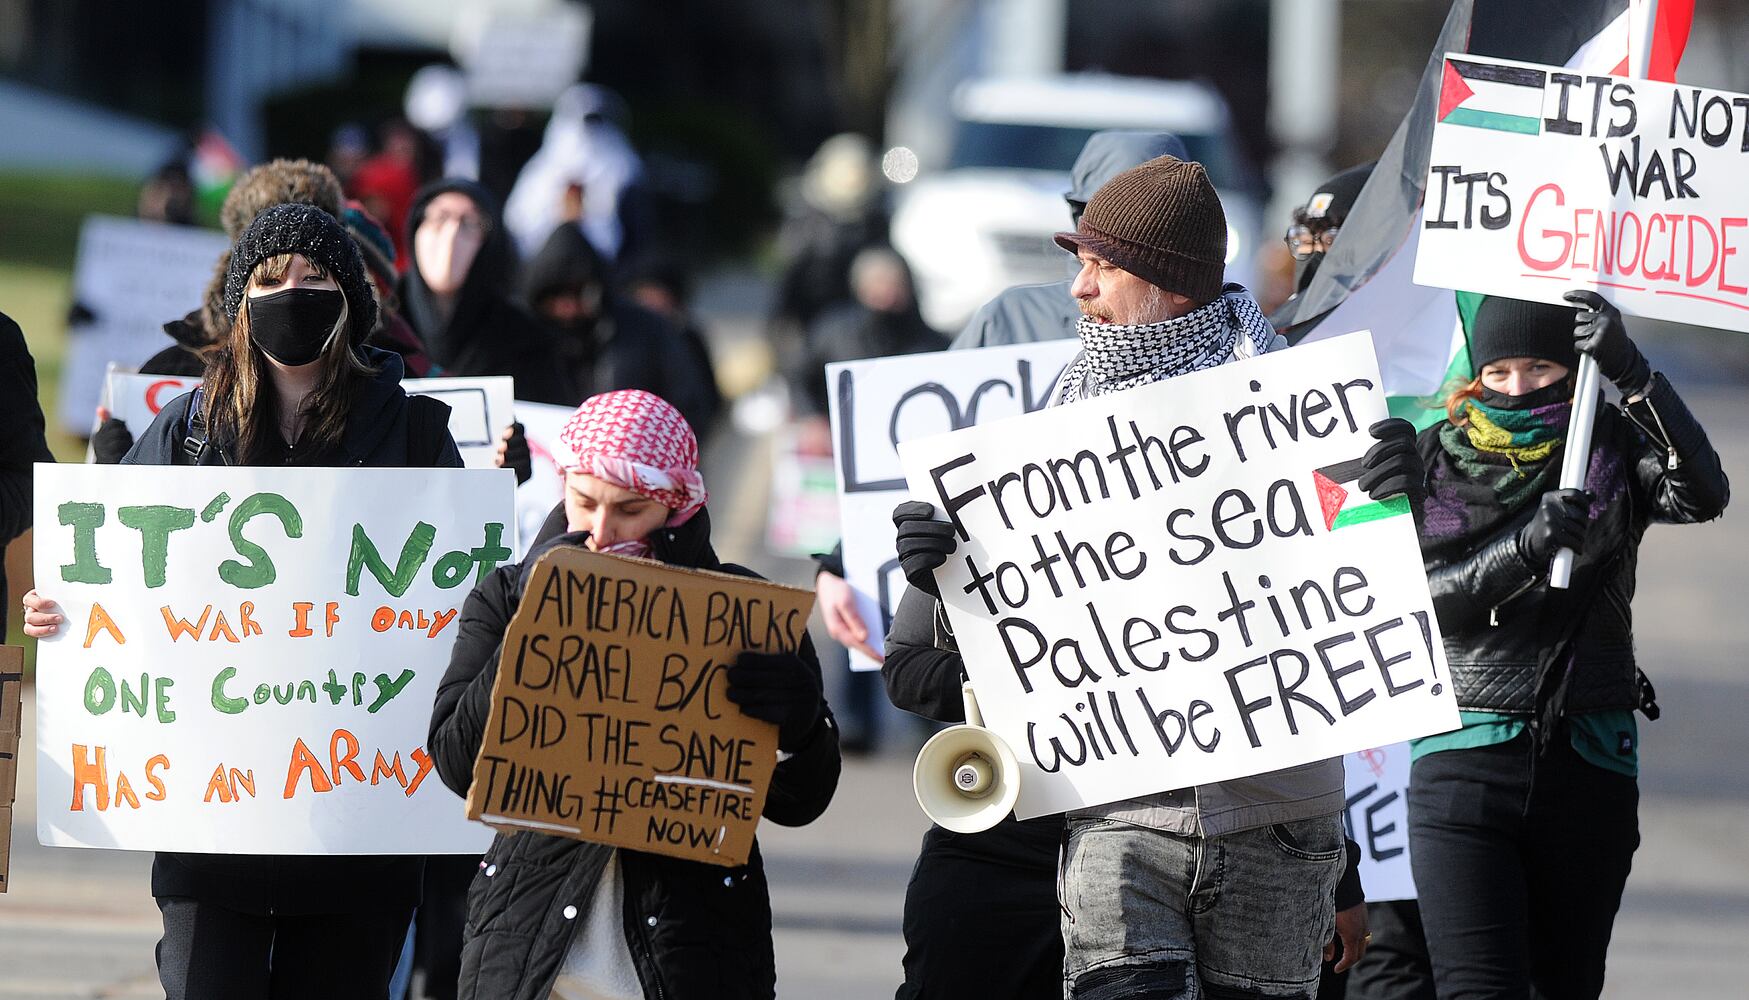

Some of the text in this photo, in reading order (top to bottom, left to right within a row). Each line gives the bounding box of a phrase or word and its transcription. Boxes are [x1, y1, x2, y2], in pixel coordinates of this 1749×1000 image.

[1544, 72, 1638, 138] ITS
[1599, 134, 1701, 201] WAR
[1425, 165, 1748, 296] ITS GENOCIDE
[1222, 378, 1375, 464] river
[57, 492, 512, 597] IT'S Not
[1167, 478, 1314, 567] sea
[83, 602, 126, 648] A
[161, 601, 263, 643] WAR
[288, 602, 340, 638] IF
[534, 565, 689, 646] AMERICA
[704, 591, 800, 654] BACKS
[996, 566, 1376, 694] Palestine
[84, 667, 416, 724] ONE Country
[515, 634, 730, 720] ISRAEL B/C
[1026, 610, 1443, 774] will be FREE!
[204, 763, 256, 803] AN
[499, 696, 757, 786] DID THE SAME
[483, 755, 753, 834] THING #CEASEFIRE
[646, 815, 728, 856] NOW!
